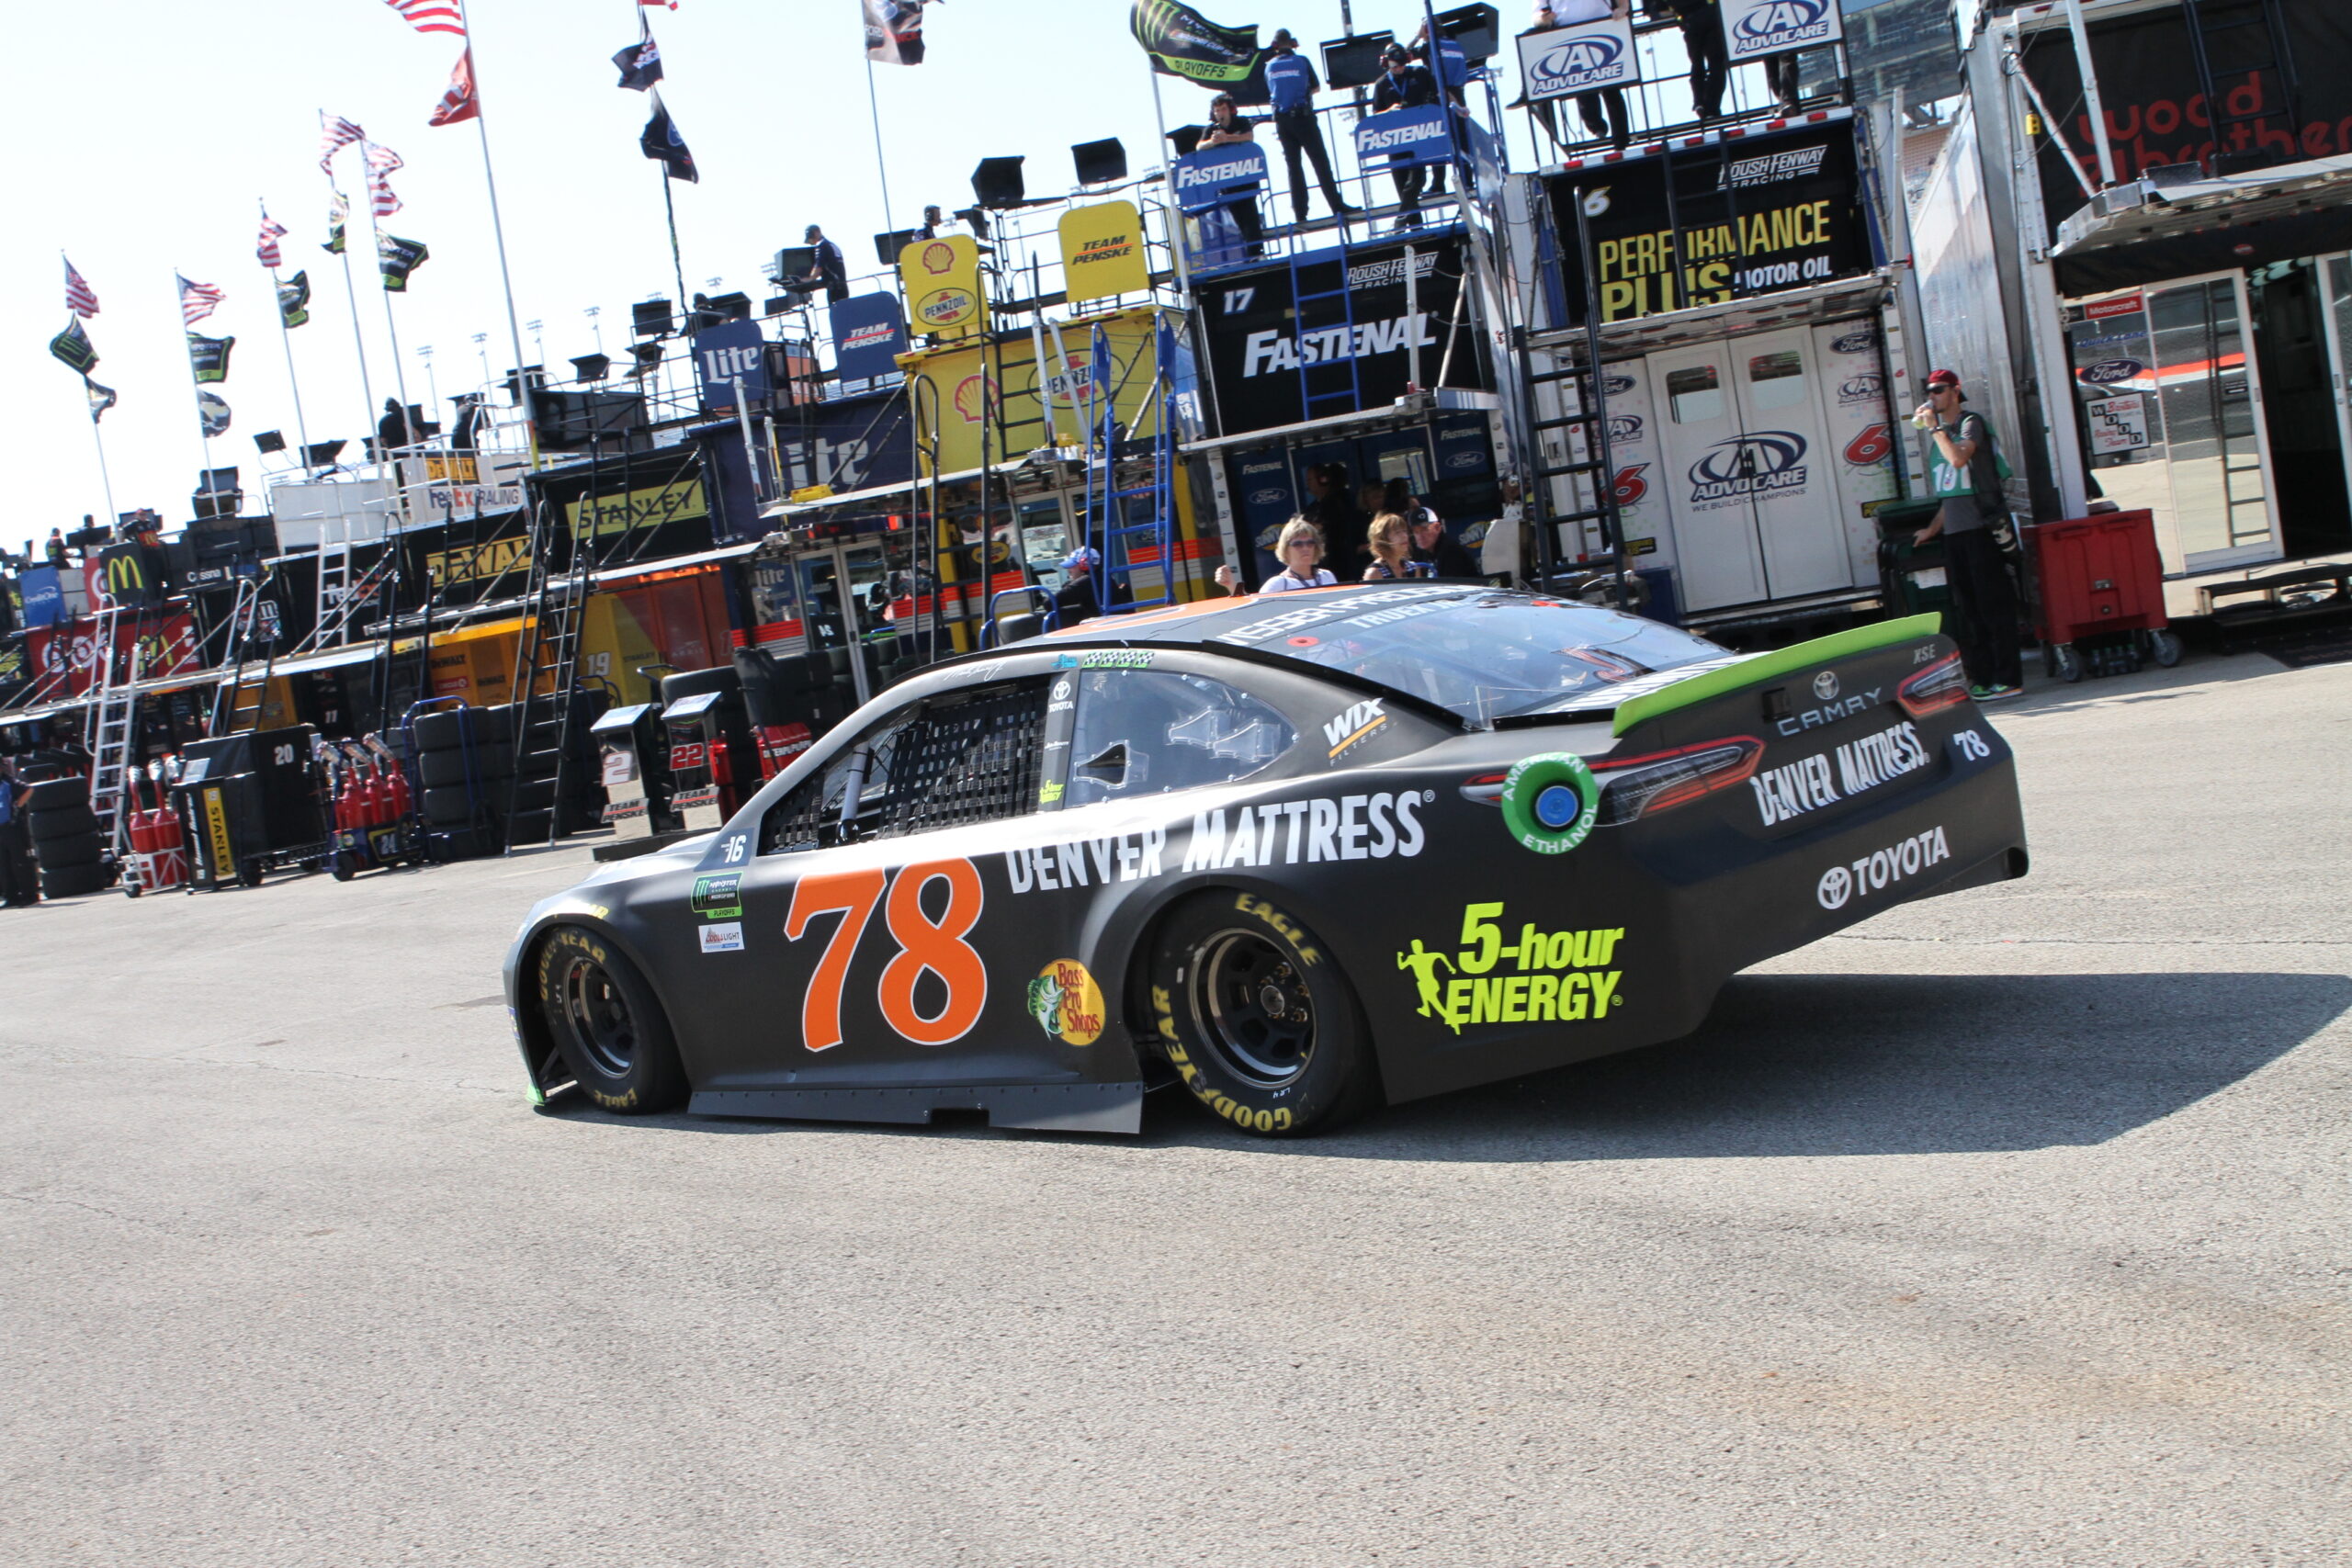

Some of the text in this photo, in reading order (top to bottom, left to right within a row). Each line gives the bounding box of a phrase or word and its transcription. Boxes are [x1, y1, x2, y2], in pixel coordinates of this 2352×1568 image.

[1736, 21, 1829, 54] ADVOCARE
[1532, 63, 1623, 95] ADVOCARE
[1358, 120, 1446, 152] FASTENAL
[1177, 158, 1263, 188] FASTENAL
[1741, 171, 1795, 188] RACING
[1583, 186, 1611, 217] 6
[1072, 247, 1133, 266] PENSKE
[1083, 235, 1126, 252] TEAM
[1802, 255, 1832, 279] OIL
[924, 295, 970, 319] PENNZOIL
[1224, 288, 1255, 315] 17
[842, 333, 895, 351] PENSKE
[849, 322, 888, 337] TEAM
[1243, 313, 1436, 378] FASTENAL
[704, 344, 760, 385] Lite
[2091, 361, 2132, 382] Ford
[1843, 422, 1892, 466] 6
[1690, 466, 1808, 502] ADVOCARE
[1914, 644, 1937, 665] XSE
[1323, 697, 1385, 747] WIX
[1778, 688, 1882, 736] CAMRY
[274, 743, 294, 766] 20
[672, 745, 701, 769] 22
[1329, 723, 1388, 767] FILTERS
[1953, 729, 1991, 762] 78
[1502, 751, 1586, 802] AMERICAN
[1750, 721, 1926, 827] DENVER MATTRESS
[211, 807, 231, 873] STANLEY
[380, 834, 397, 855] 24
[1006, 790, 1425, 894] DENVER MATTRESS
[1522, 804, 1598, 854] ETHANOL
[1852, 826, 1951, 897] TOYOTA
[1235, 893, 1324, 967] EAGLE
[1458, 902, 1625, 975] 5-hour
[784, 856, 988, 1053] 78
[1057, 963, 1084, 988] Bass
[1063, 988, 1082, 1011] Pro
[1444, 971, 1623, 1025] ENERGY
[1067, 1012, 1102, 1039] Shops
